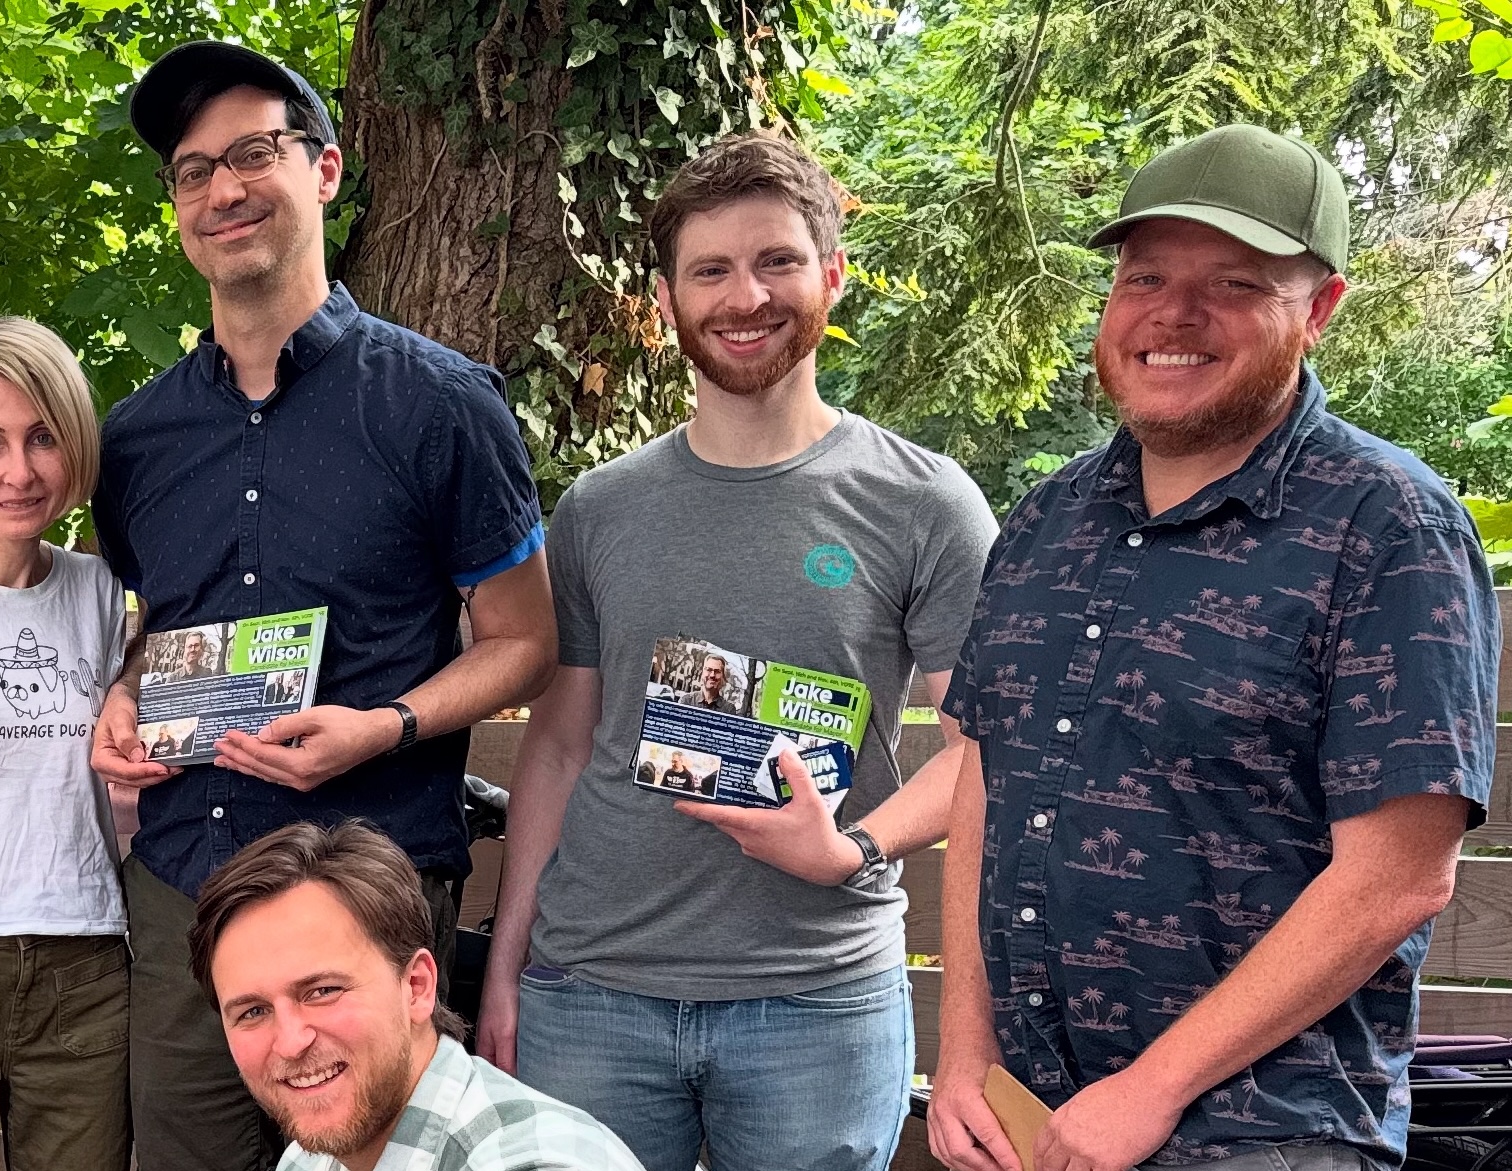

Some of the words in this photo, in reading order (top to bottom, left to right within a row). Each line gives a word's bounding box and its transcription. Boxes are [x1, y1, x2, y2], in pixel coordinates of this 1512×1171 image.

[249, 623, 296, 645] Jake
[248, 643, 309, 665] Wilson
[781, 676, 833, 704] Jake
[778, 697, 847, 731] Wilson
[59, 723, 87, 738] PUG
